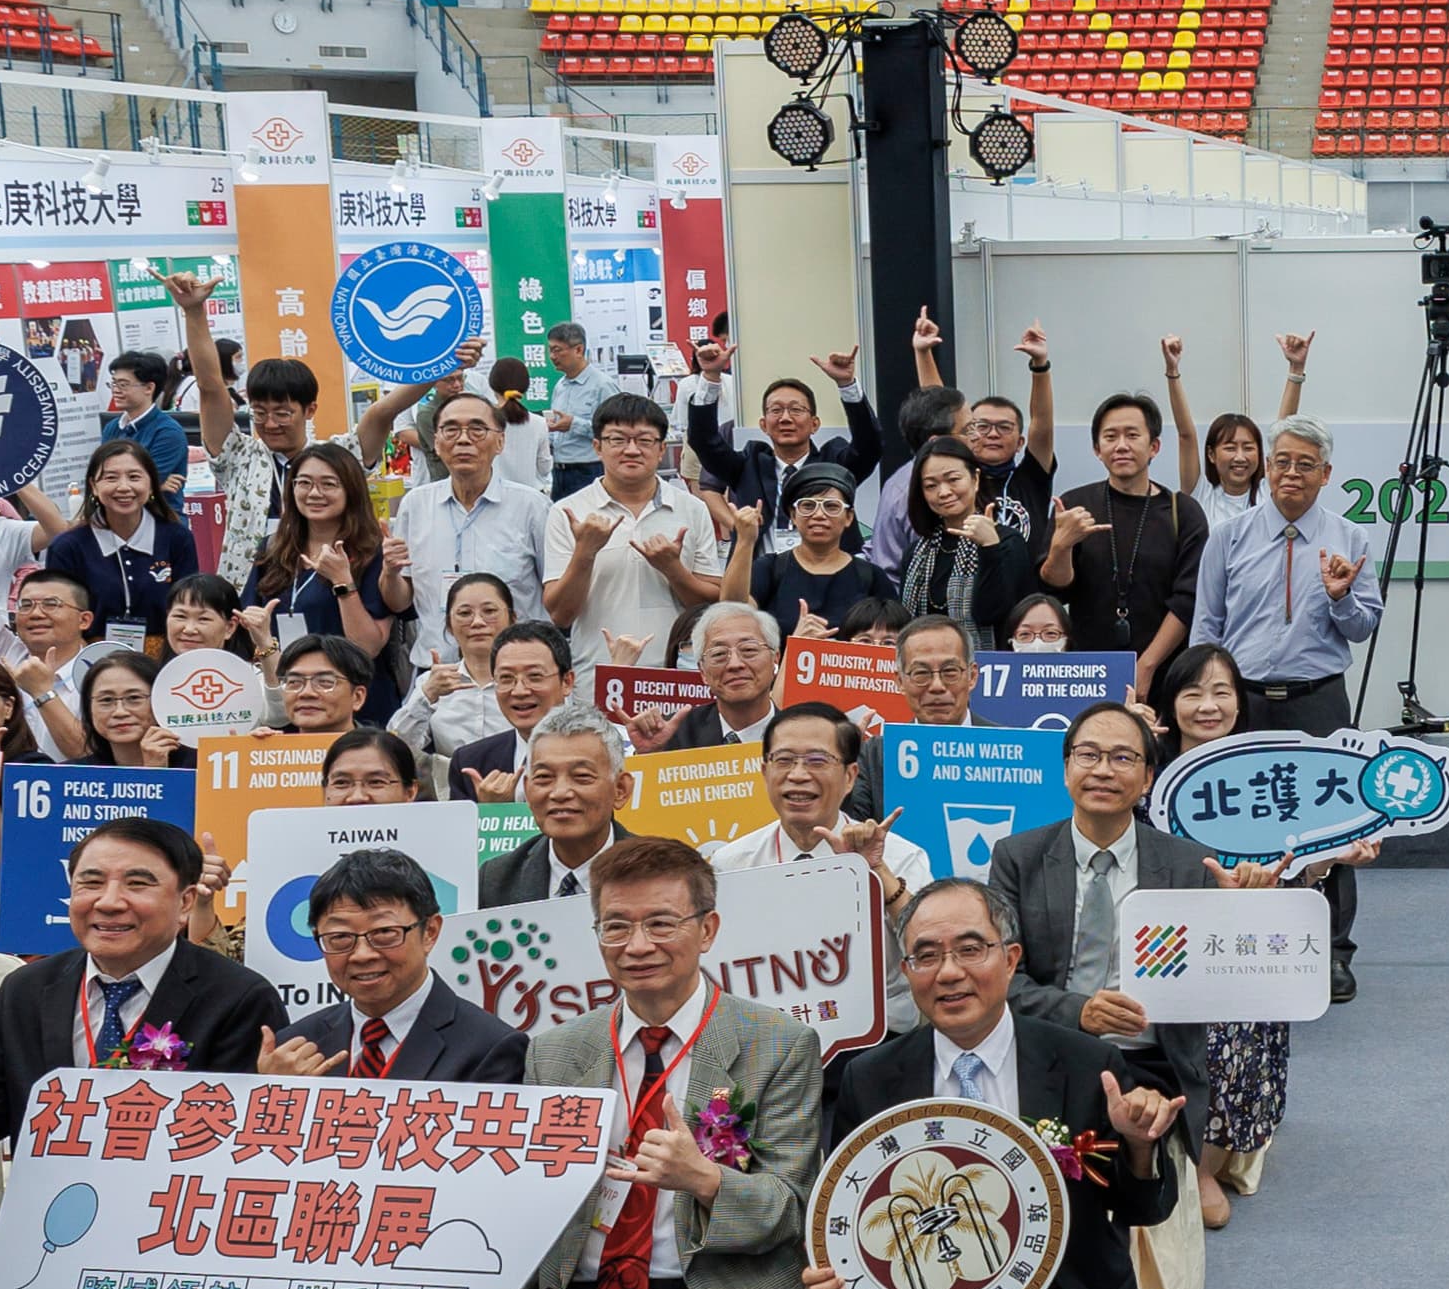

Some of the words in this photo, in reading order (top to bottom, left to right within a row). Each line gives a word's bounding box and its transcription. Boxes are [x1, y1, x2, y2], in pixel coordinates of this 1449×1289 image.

[258, 155, 317, 165] 庚科技大學
[211, 178, 224, 193] 25
[472, 189, 480, 201] 25
[338, 193, 426, 227] 庚科技大學
[569, 198, 617, 227] 科技大學
[346, 245, 465, 281] 國立臺灣海洋大學
[275, 286, 309, 358] 高齡
[335, 287, 353, 349] NATIONAL
[518, 277, 548, 401] 綠色照護
[356, 352, 403, 381] TAIWAN
[412, 356, 457, 381] OCEAN
[12, 360, 55, 436] UNIVERSITY
[14, 442, 50, 484] OCEAN
[797, 651, 816, 684] 9
[821, 653, 873, 672] INDUSTRY,
[1023, 664, 1107, 679] PARTNERSHIPS
[634, 680, 675, 696] DECENT
[677, 682, 710, 698] WORK
[819, 674, 841, 687] AND
[980, 664, 1010, 697] 17
[1022, 684, 1045, 697] FOR
[1047, 684, 1067, 697] THE
[1069, 684, 1107, 697] GOALS
[605, 678, 624, 712] 8
[898, 740, 919, 779] 6
[932, 741, 975, 758] CLEAN
[979, 744, 1024, 760] WATER
[207, 751, 240, 790] 11
[250, 774, 276, 788] AND
[280, 772, 325, 788] COMM
[658, 760, 741, 784] AFFORDABLE
[743, 756, 763, 773] AN
[932, 765, 960, 781] AND
[965, 766, 1043, 784] SANITATION
[13, 780, 51, 819] 16
[64, 781, 108, 799] PEACE,
[111, 784, 164, 800] JUSTICE
[660, 787, 701, 807] CLEAN
[705, 781, 755, 801] ENERGY
[1192, 762, 1354, 822] 北護大
[63, 805, 90, 820] AND
[94, 805, 148, 819] STRONG
[503, 815, 540, 831] HEAL
[327, 827, 399, 844] TAIWAN
[1203, 934, 1320, 956] 永續臺大
[1205, 965, 1288, 975] SUSTAINABLE
[1294, 965, 1318, 974] NTU
[279, 983, 309, 1006] To
[29, 1076, 604, 1178] 社會參與跨校共學
[138, 1173, 437, 1267] 北區聯展
